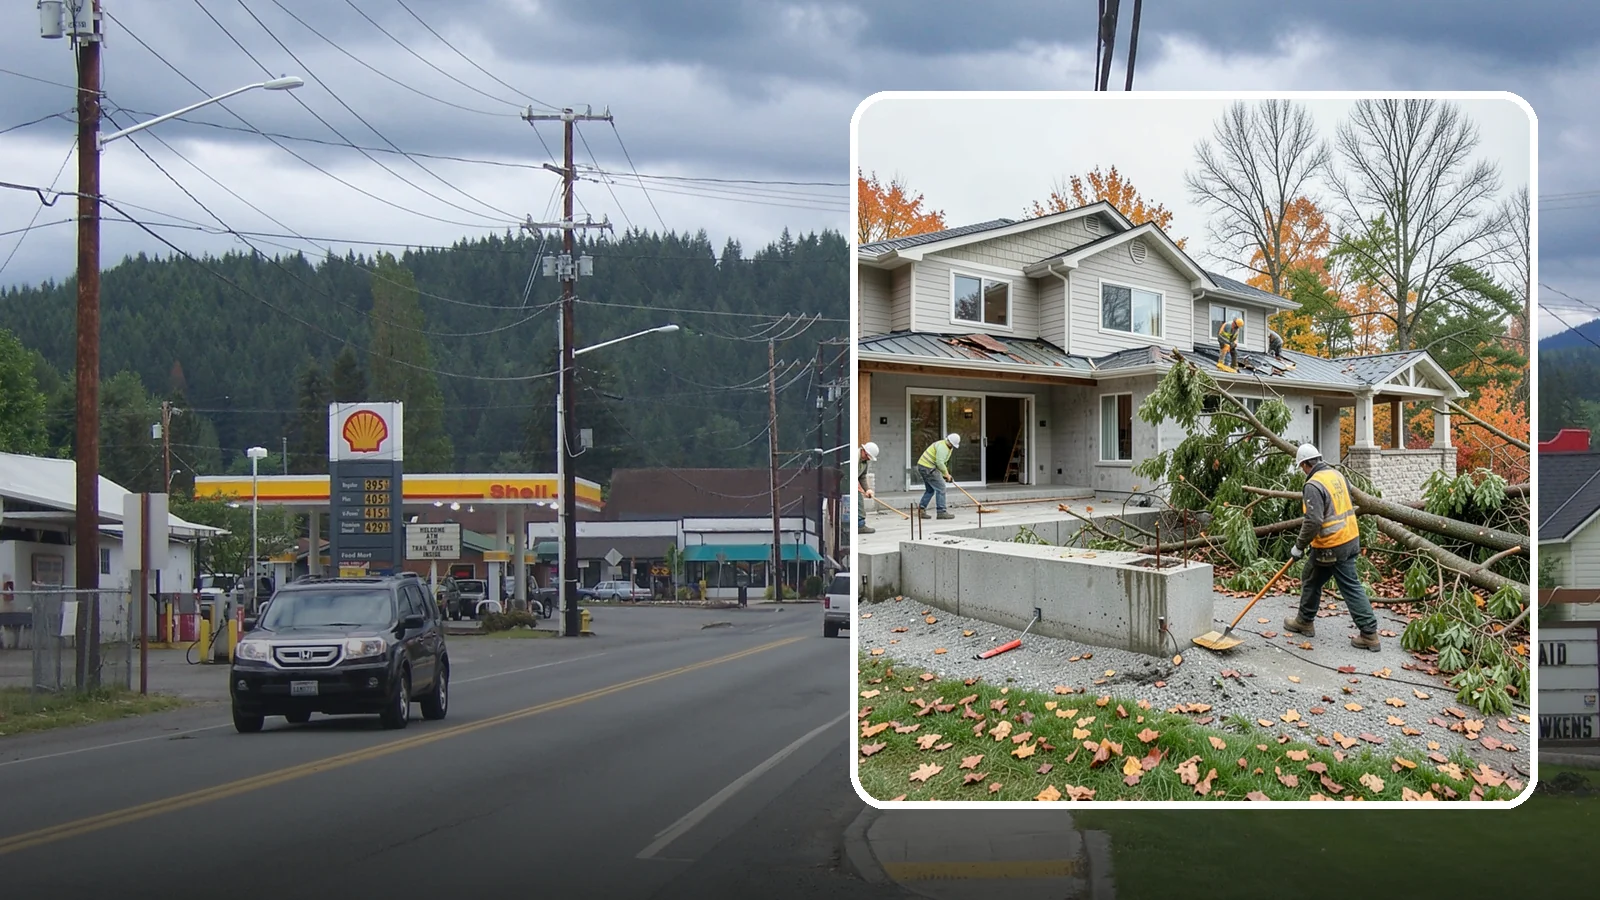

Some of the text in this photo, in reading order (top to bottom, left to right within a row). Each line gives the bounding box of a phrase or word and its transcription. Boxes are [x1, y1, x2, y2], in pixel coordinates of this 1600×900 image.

[366, 480, 383, 490] 395
[490, 484, 547, 499] Shell
[366, 494, 383, 504] 405
[366, 508, 383, 518] 415
[366, 522, 383, 532] 429
[1538, 643, 1566, 665] AID
